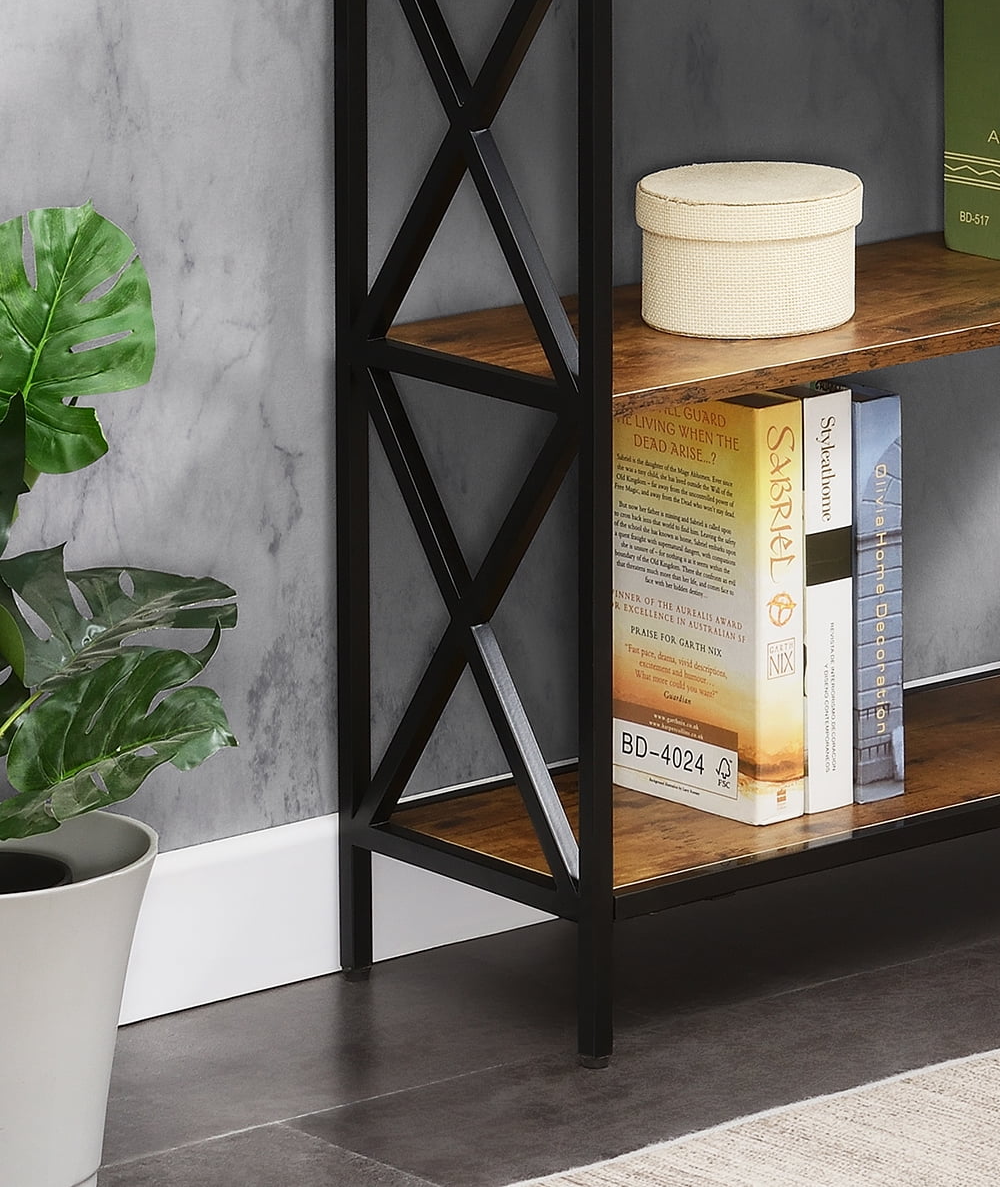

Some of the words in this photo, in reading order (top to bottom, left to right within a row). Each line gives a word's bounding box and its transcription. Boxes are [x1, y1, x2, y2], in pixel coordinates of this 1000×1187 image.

[959, 210, 990, 227] BD-517
[683, 406, 726, 428] GUARD
[633, 433, 667, 453] DEAD
[635, 414, 676, 435] LIVING
[678, 424, 714, 445] WHEN
[715, 433, 740, 451] THE
[616, 472, 626, 481] Old
[815, 416, 836, 523] Styleathome
[680, 498, 693, 508] Dead
[766, 425, 796, 584] SABRIEL
[875, 463, 887, 527] Olivia
[649, 558, 660, 567] Old
[875, 531, 888, 595] Home
[615, 588, 642, 604] INNER
[644, 596, 655, 608] OF
[658, 600, 673, 612] THE
[675, 604, 712, 623] AUREALIS
[715, 615, 743, 631] AWARD
[623, 602, 675, 625] EXCELLENCE
[676, 617, 686, 628] IN
[688, 620, 736, 641] AUSTRALIAN
[630, 625, 658, 641] PRAISE
[660, 632, 677, 646] FOR
[678, 637, 706, 653] GARTH
[708, 645, 723, 658] NIX
[769, 642, 794, 654] GARTH
[638, 661, 672, 675] excitement
[672, 669, 683, 679] and
[678, 658, 693, 670] vivid
[769, 650, 794, 677] NIX
[830, 654, 836, 665] DE
[875, 602, 889, 734] Decoration
[634, 669, 652, 682] What
[652, 676, 669, 686] more
[669, 680, 685, 691] could
[686, 685, 698, 695] you
[662, 691, 693, 704] Guardian
[621, 731, 704, 776] BD-4024
[717, 779, 731, 790] FSC
